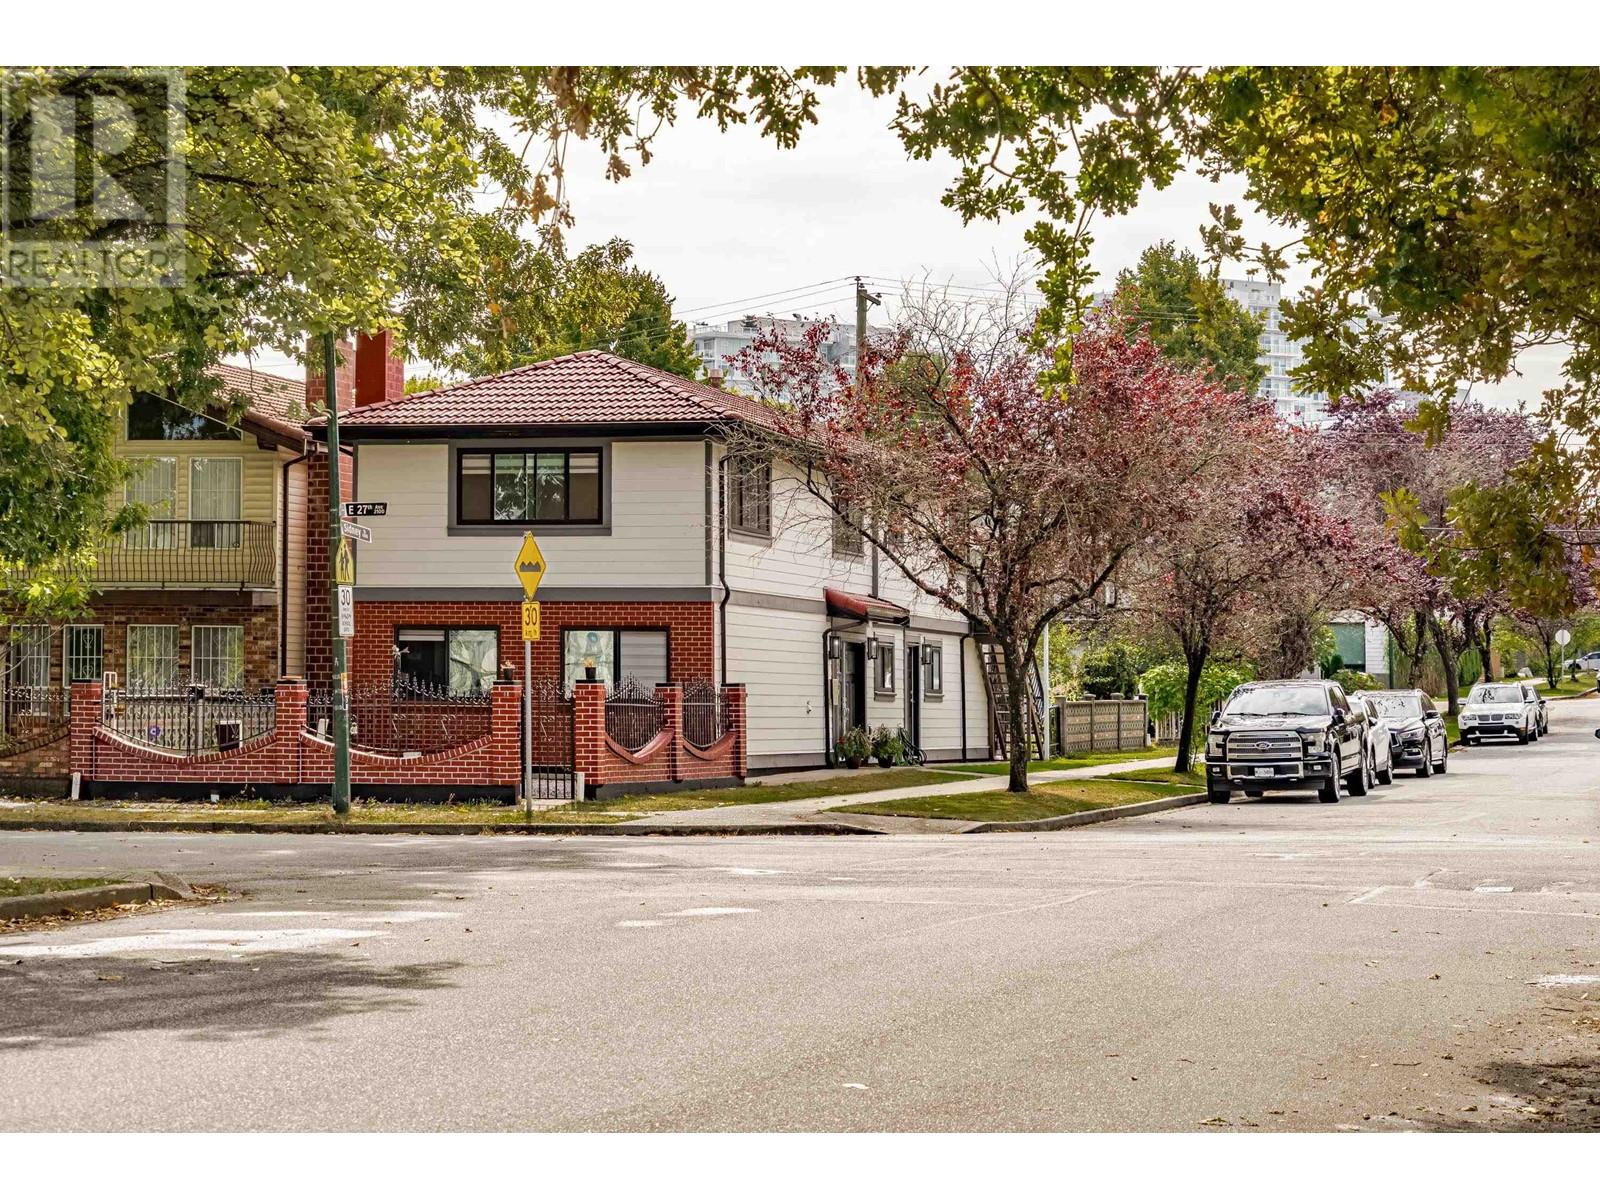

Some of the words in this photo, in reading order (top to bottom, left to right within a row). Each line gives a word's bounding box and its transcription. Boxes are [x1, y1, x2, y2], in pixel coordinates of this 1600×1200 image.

[348, 504, 354, 515] E
[341, 589, 351, 606] 30
[524, 607, 538, 626] 30
